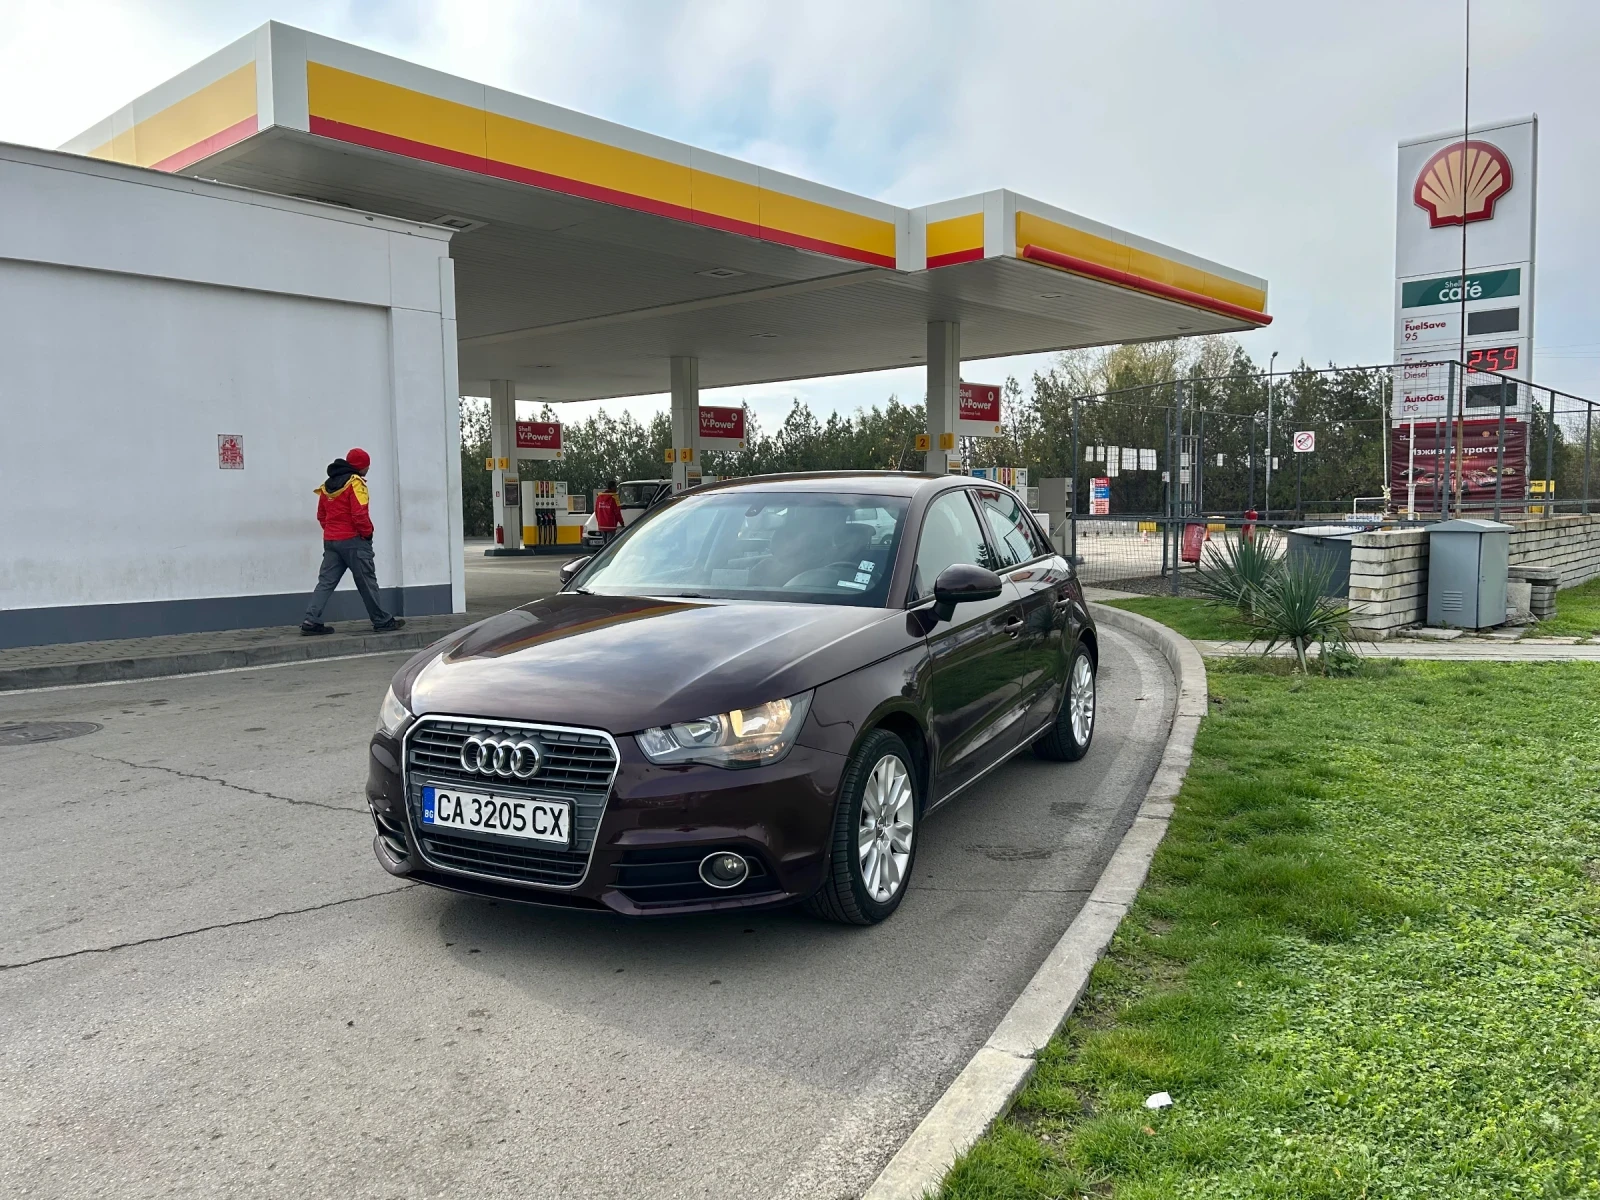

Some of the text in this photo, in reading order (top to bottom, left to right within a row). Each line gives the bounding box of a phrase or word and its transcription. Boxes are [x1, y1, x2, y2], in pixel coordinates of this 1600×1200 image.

[1438, 281, 1482, 301] café
[1405, 321, 1446, 331] FuelSave
[1404, 332, 1418, 341] 95
[1467, 348, 1518, 373] 259
[1404, 369, 1428, 379] Diesel
[1404, 394, 1445, 403] AutoGas
[960, 398, 992, 410] V-Power
[1403, 404, 1419, 412] LPG
[701, 419, 735, 429] V-Power
[518, 432, 552, 441] V-Power
[920, 438, 926, 447] 2
[424, 809, 434, 819] BG
[437, 793, 564, 838] CA 3205 CX
